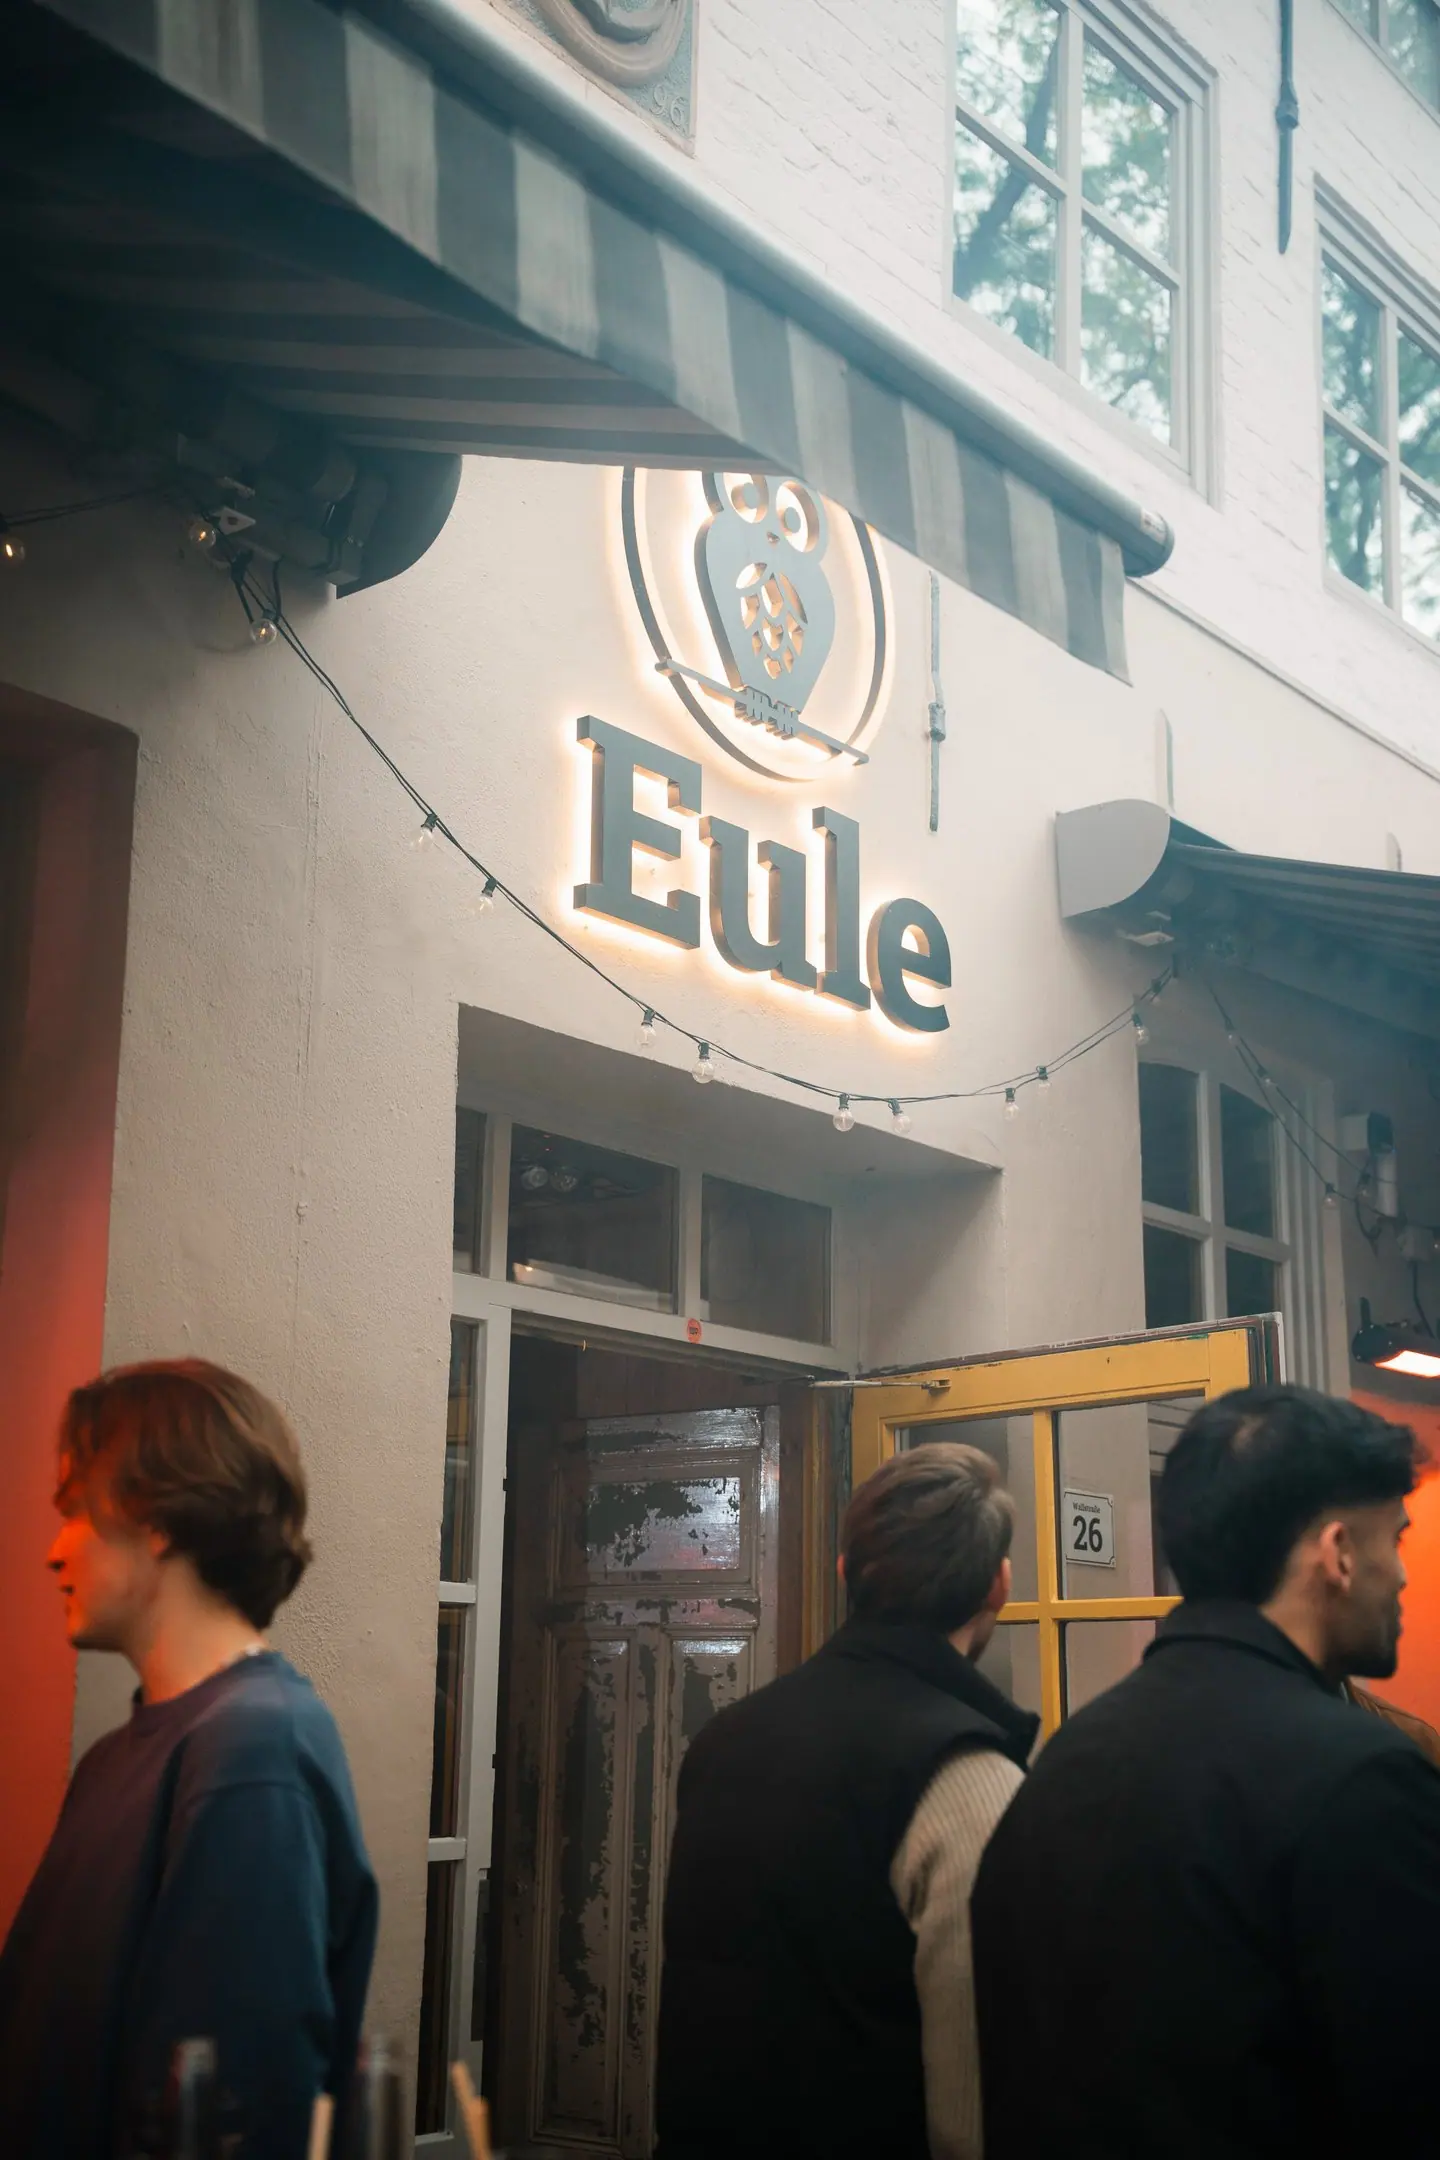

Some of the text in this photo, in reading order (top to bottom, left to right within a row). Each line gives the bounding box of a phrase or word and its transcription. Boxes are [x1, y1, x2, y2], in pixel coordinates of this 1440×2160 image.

[650, 84, 686, 127] 96
[573, 715, 952, 1033] Eule
[1073, 1515, 1103, 1552] 26
